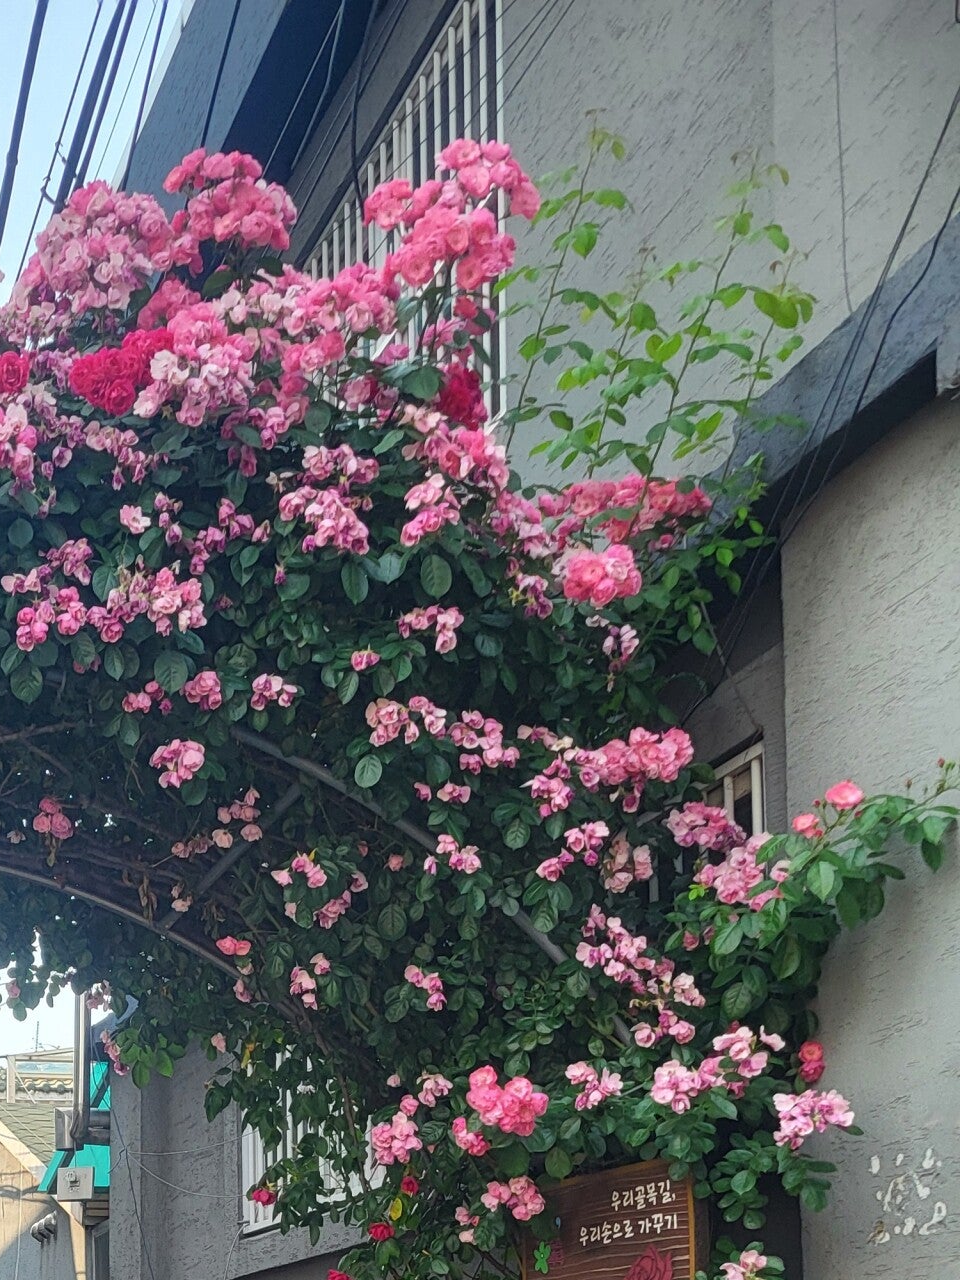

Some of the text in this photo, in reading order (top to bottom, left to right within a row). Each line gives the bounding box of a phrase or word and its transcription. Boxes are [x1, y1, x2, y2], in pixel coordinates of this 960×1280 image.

[611, 1179, 676, 1211] 우리골목길,
[579, 1212, 678, 1246] 우리손으로 가꾸기
